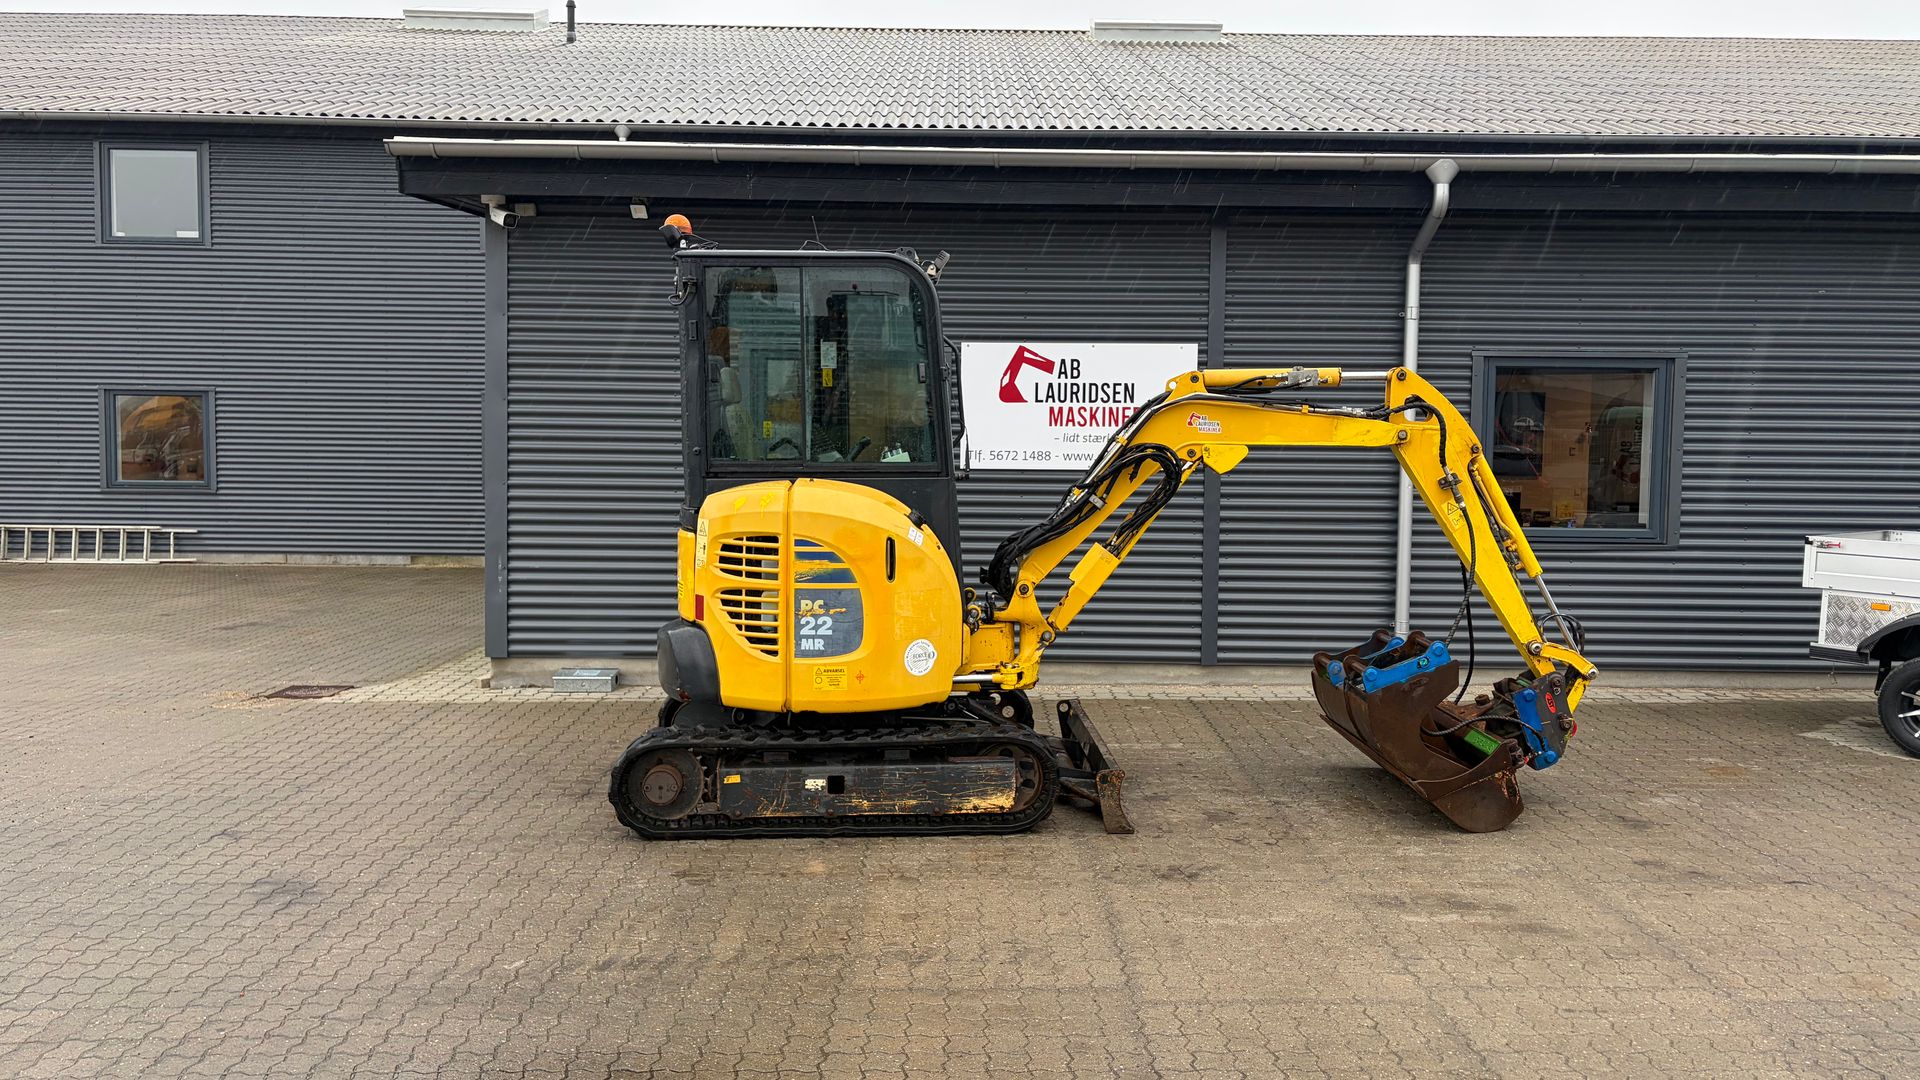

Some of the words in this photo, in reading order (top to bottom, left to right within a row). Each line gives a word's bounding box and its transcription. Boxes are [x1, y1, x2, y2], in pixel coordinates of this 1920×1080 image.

[1057, 358, 1081, 380] AB
[1034, 382, 1135, 404] LAURIDSEN
[1062, 432, 1080, 443] lidt
[1082, 433, 1110, 443] stær
[968, 449, 986, 463] Tlf.
[989, 450, 1018, 461] 5672
[1022, 450, 1052, 461] 1488
[800, 599, 824, 612] PC
[799, 616, 833, 636] 22
[800, 638, 825, 651] MR
